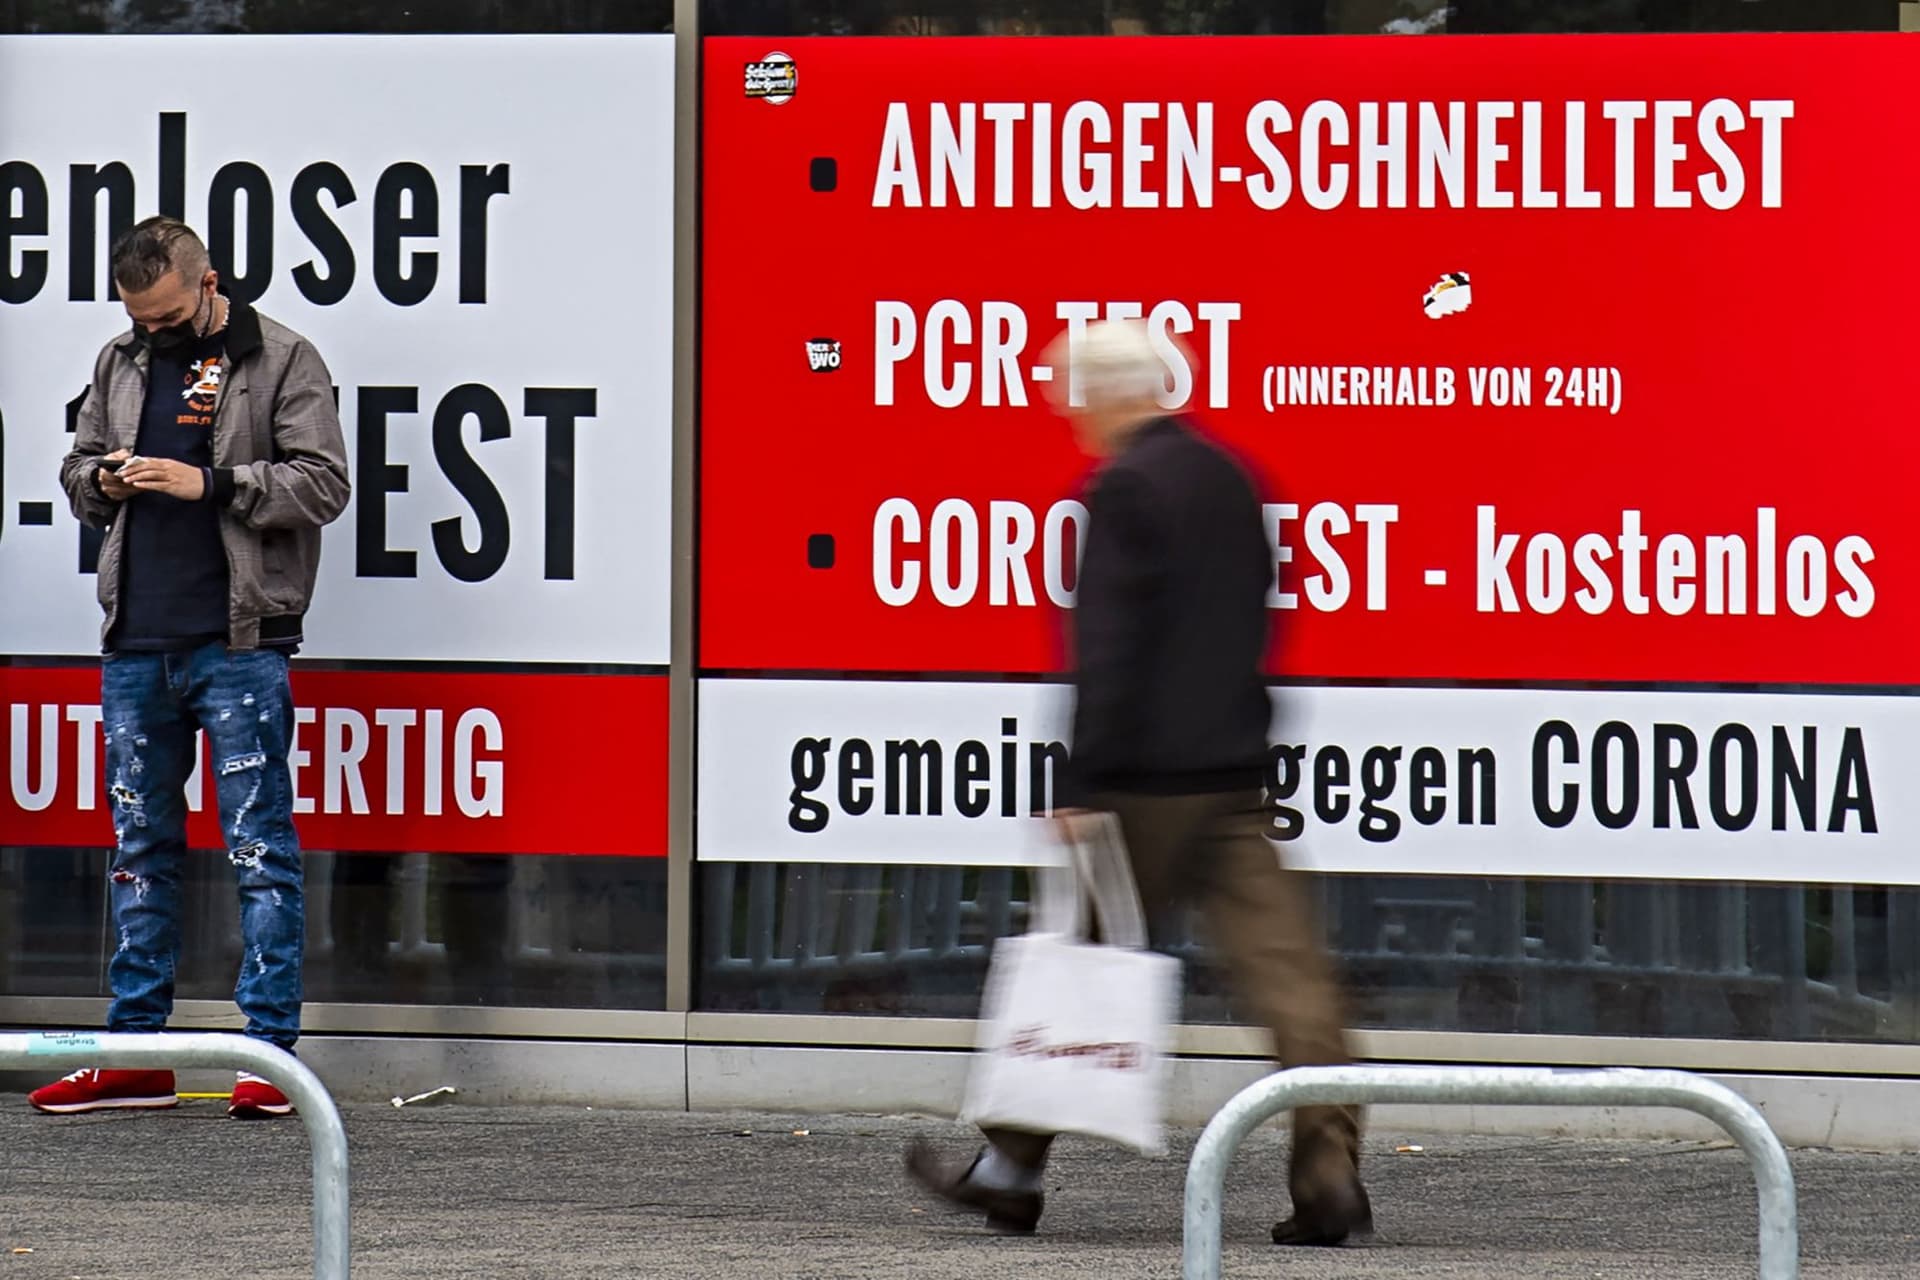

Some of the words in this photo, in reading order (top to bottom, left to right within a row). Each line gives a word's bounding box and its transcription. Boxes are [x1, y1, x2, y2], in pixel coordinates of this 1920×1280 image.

[872, 99, 1795, 210] ANTIGEN-SCHNELLTEST
[1262, 366, 1456, 413] (INNERHALB
[1468, 367, 1531, 406] VON
[1544, 367, 1622, 414] 24H)
[1424, 569, 1447, 586] -
[1476, 505, 1876, 618] kostenlos
[290, 708, 504, 818] ERTIG
[1263, 744, 1496, 842] gegen
[1532, 720, 1878, 834] CORONA
